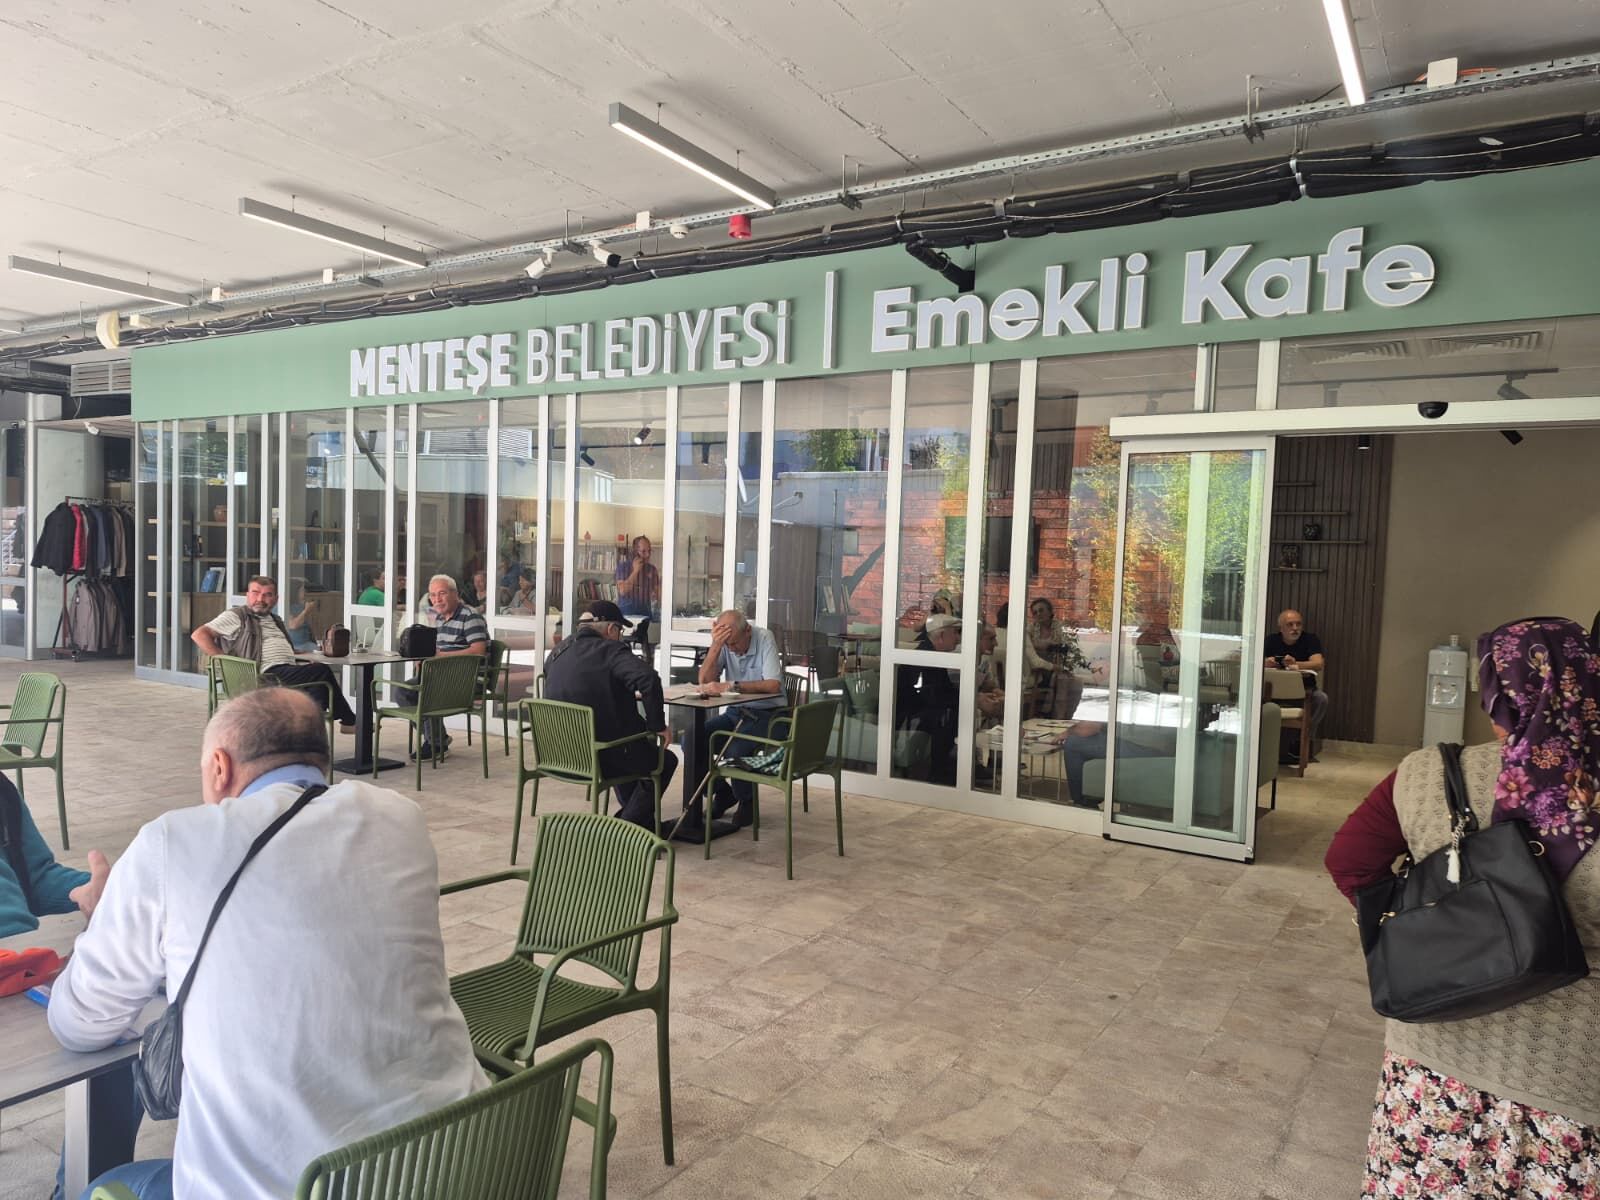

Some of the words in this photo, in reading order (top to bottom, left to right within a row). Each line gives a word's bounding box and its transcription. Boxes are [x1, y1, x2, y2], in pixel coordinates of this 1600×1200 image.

[350, 333, 515, 396] MENTEŞE
[871, 252, 1148, 353] Emekli
[1182, 226, 1435, 325] Kafe
